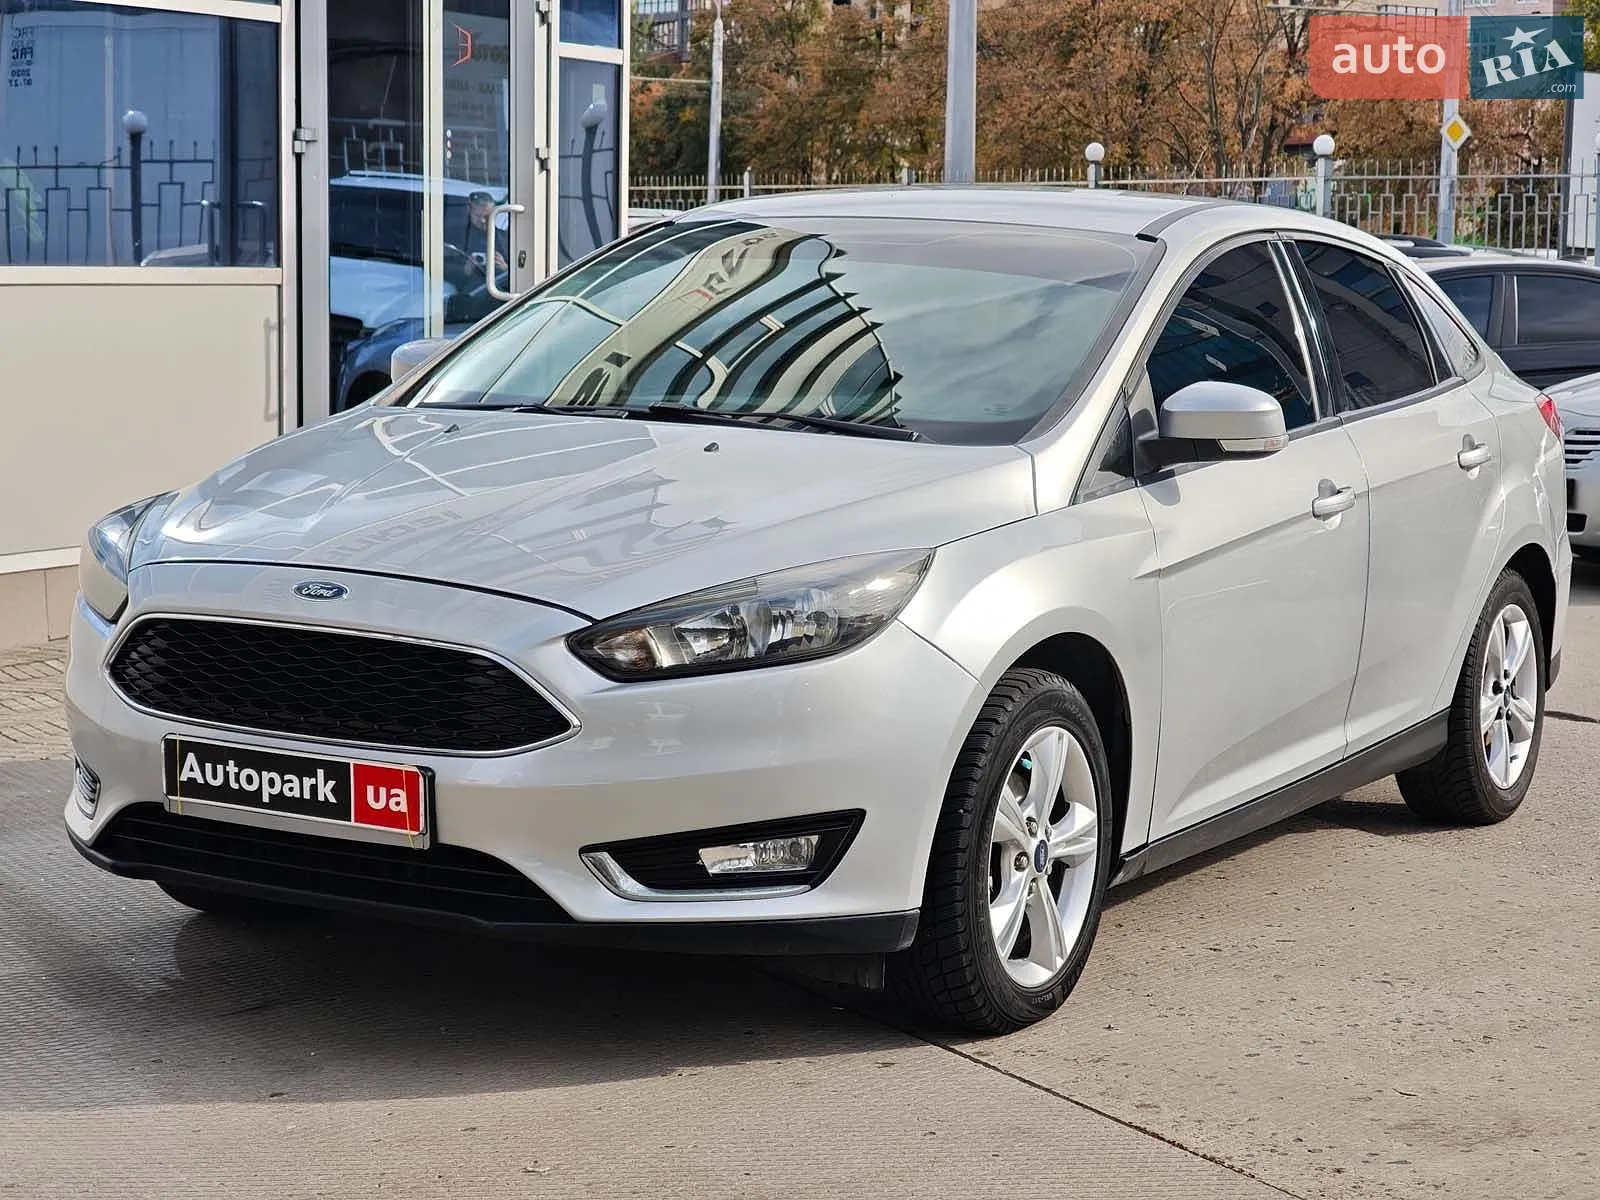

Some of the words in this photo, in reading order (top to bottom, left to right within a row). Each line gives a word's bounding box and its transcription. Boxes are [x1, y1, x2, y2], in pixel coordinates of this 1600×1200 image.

[302, 583, 340, 598] Ford
[179, 752, 338, 804] Autopark
[366, 784, 408, 813] ua
